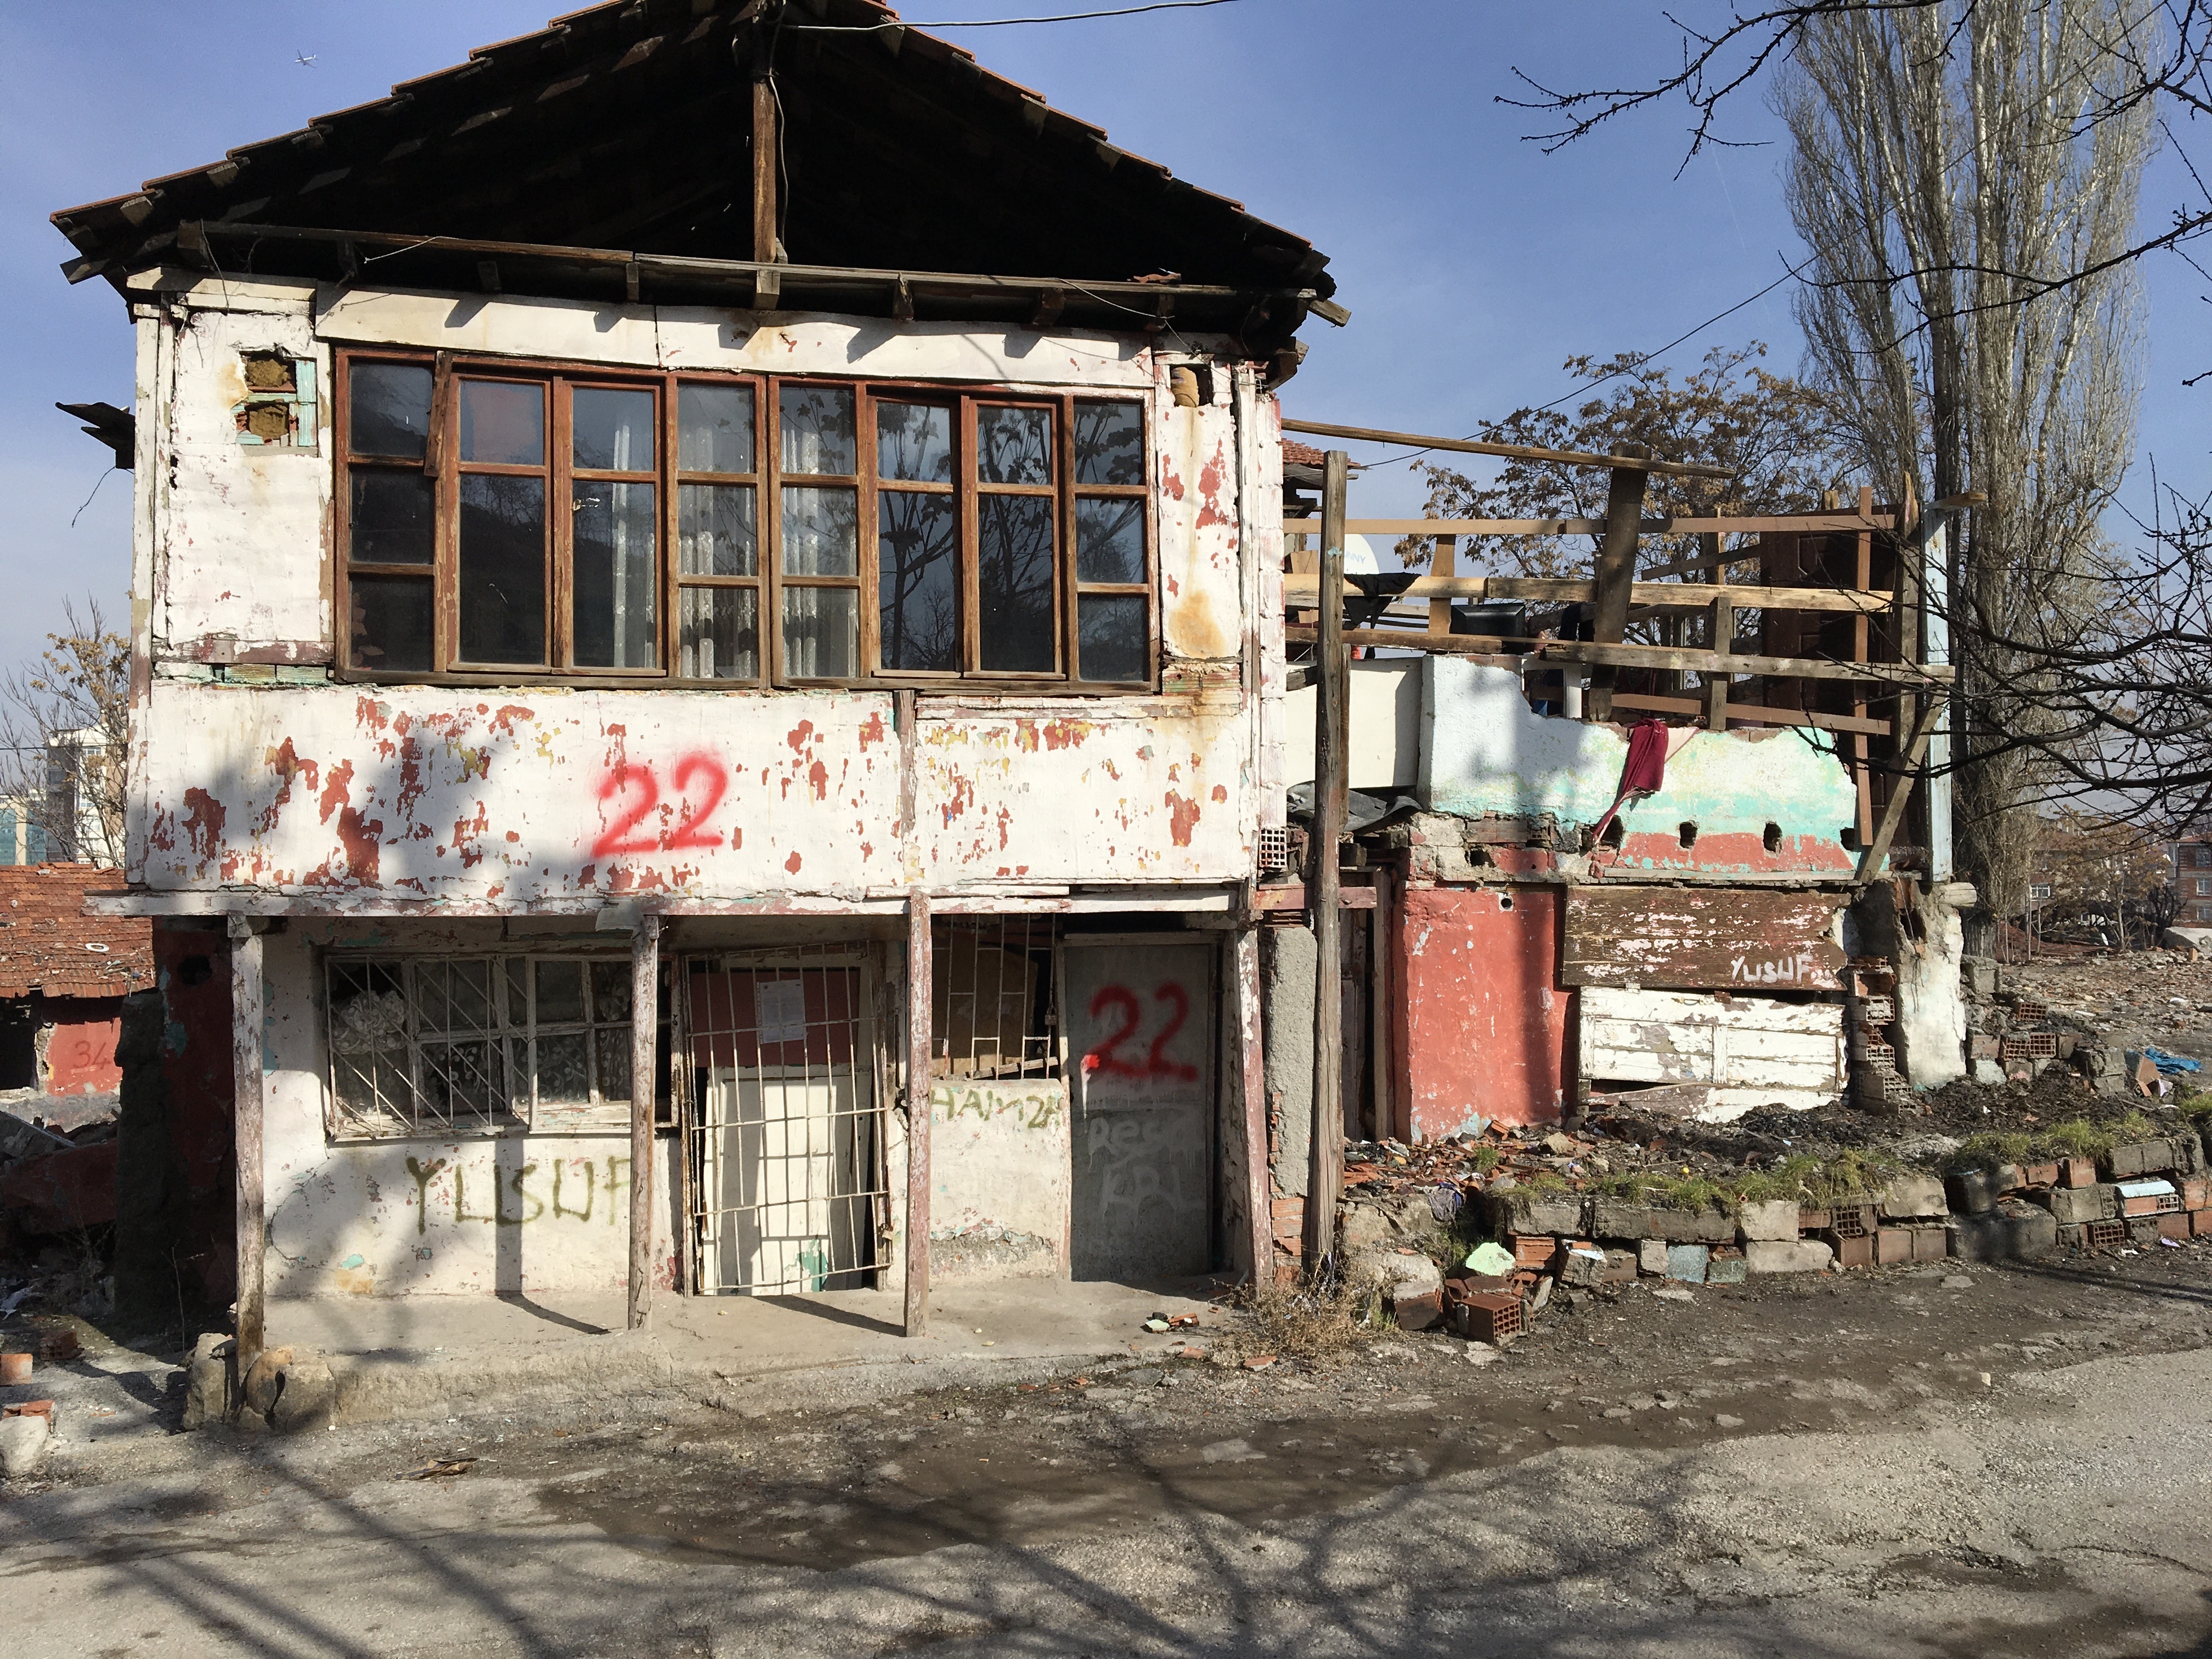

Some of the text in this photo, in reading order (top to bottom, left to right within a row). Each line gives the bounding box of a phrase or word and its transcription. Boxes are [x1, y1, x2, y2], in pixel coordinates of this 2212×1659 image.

[592, 752, 727, 857] 22
[1730, 953, 1813, 983] YUSUF
[73, 1040, 112, 1070] 34
[1081, 982, 1198, 1082] 22
